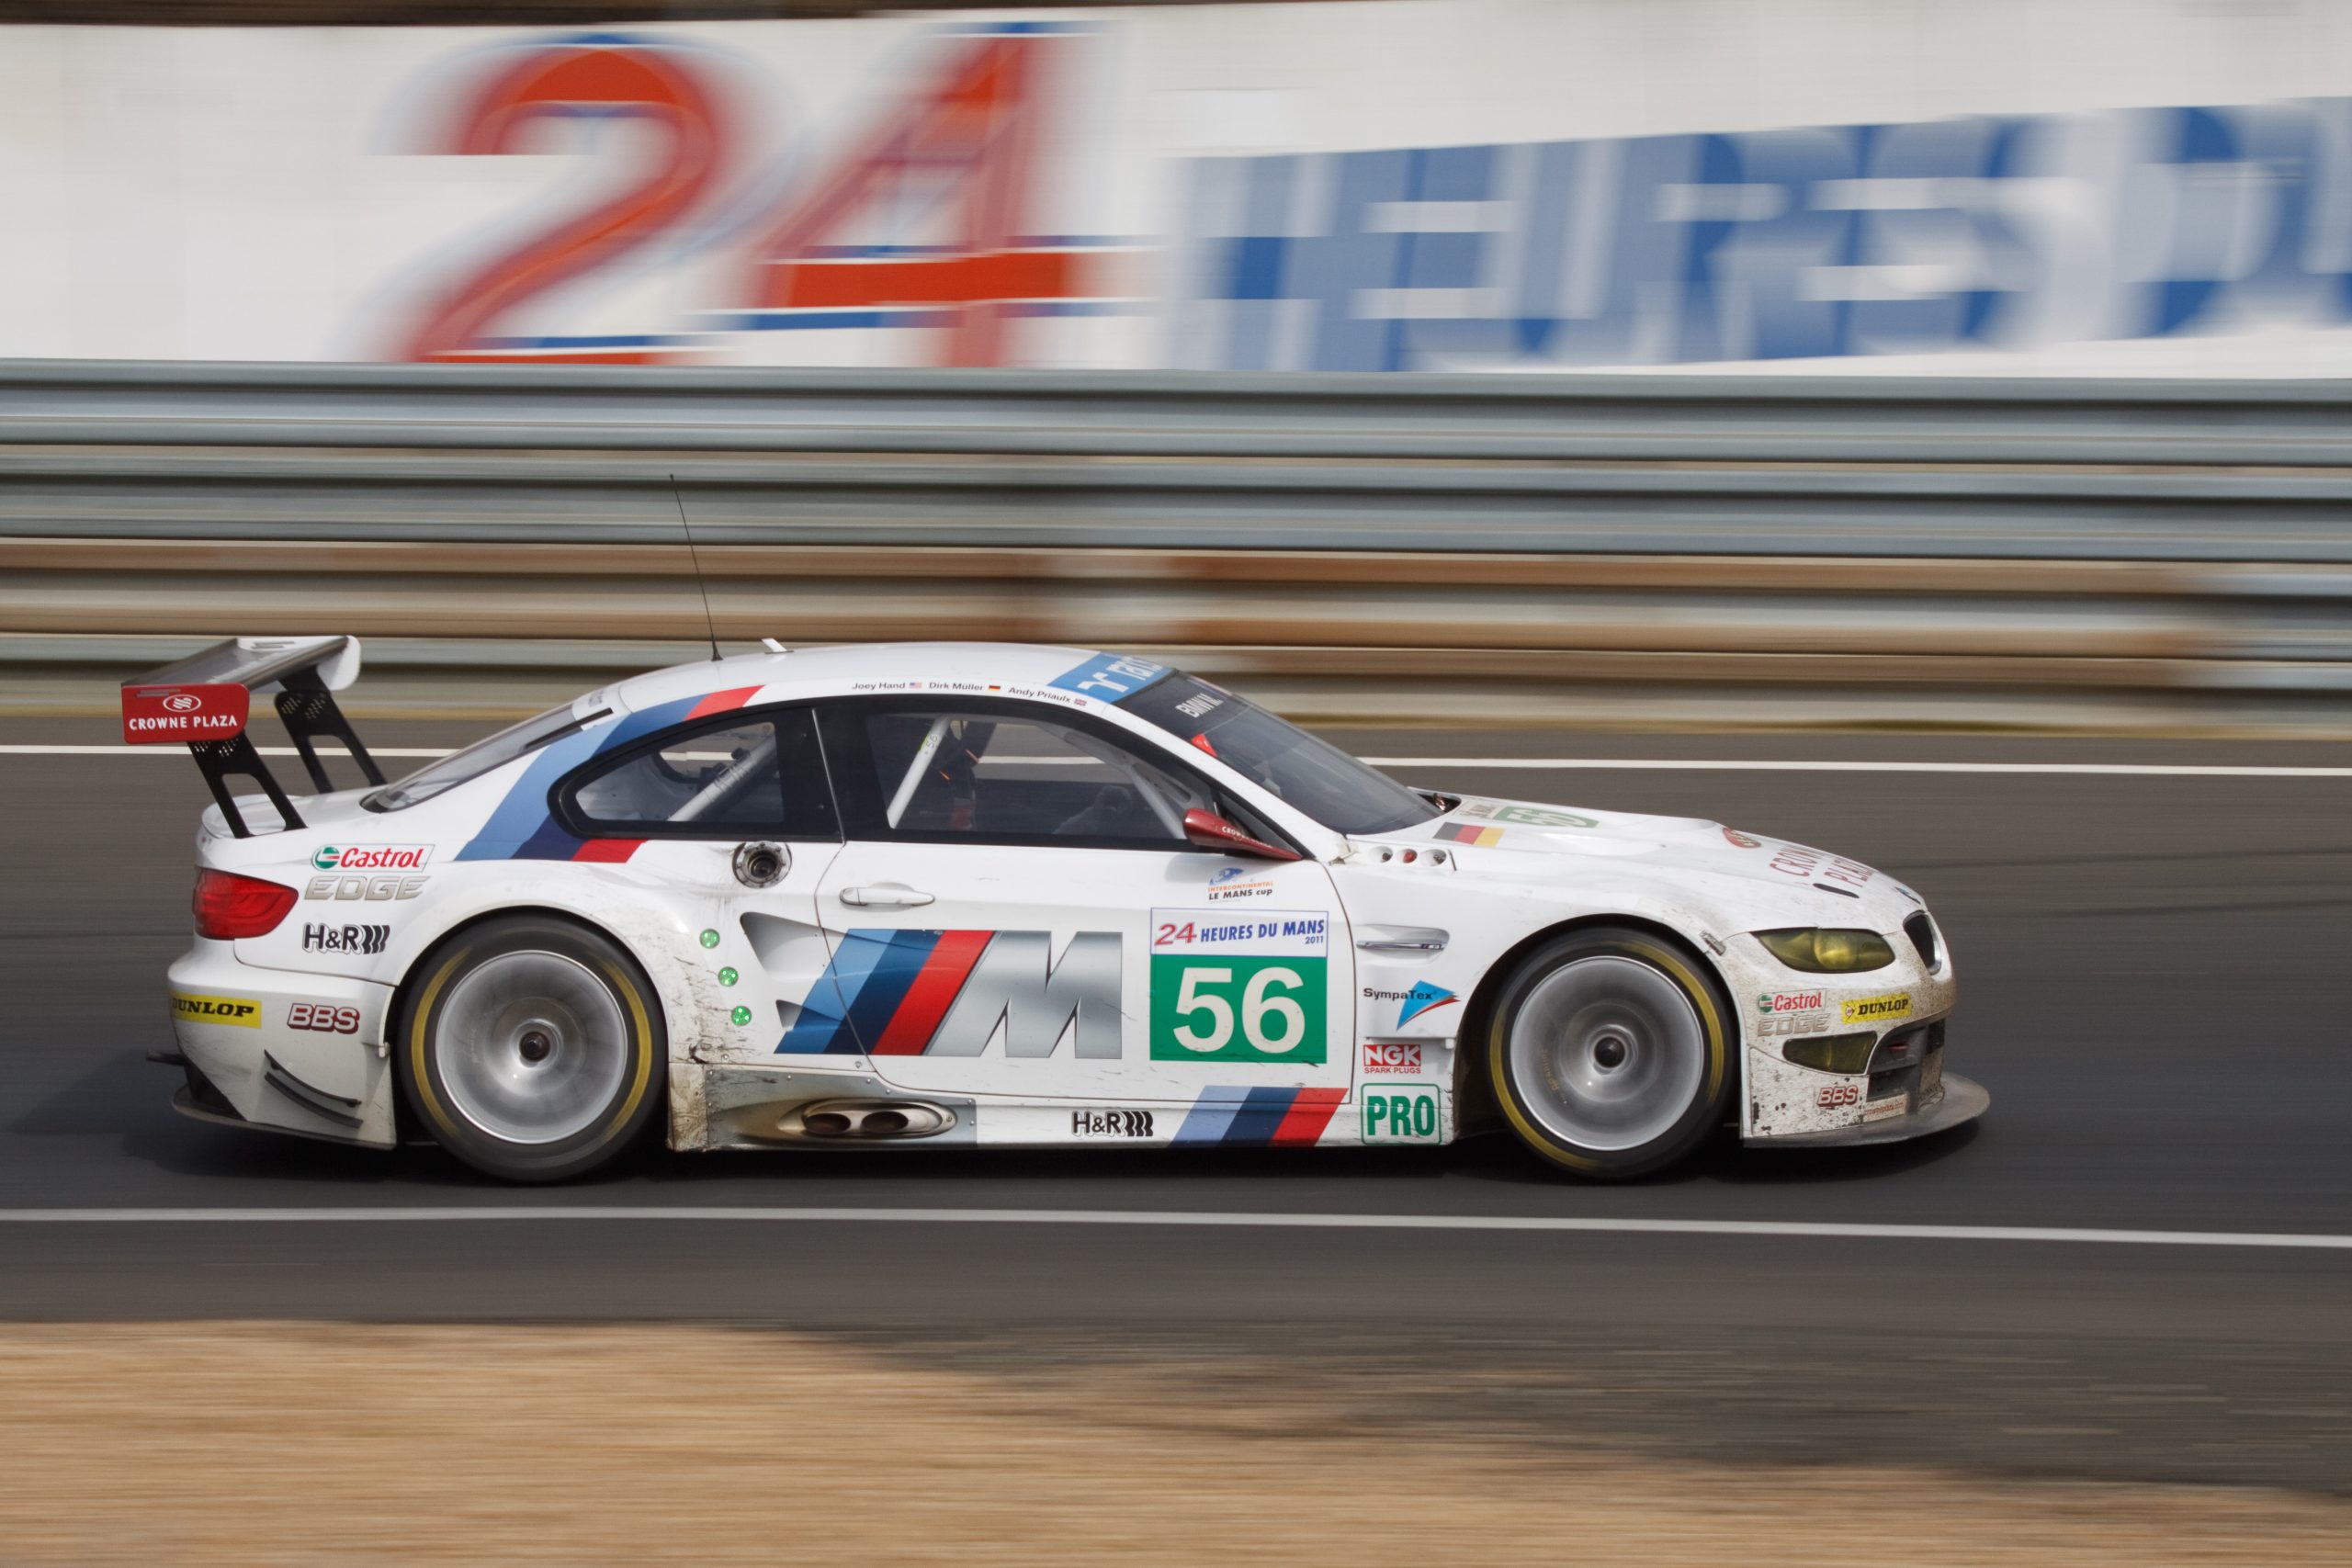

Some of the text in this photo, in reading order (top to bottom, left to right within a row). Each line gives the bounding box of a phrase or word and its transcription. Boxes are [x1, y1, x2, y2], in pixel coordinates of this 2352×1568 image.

[372, 20, 1135, 366] 24
[852, 682, 876, 691] Joey
[952, 682, 984, 691] Müller
[1008, 687, 1071, 703] Andy Priaulx
[129, 715, 238, 731] CROWNE PLAZA
[339, 846, 424, 869] Castrol
[304, 875, 431, 901] EDGE
[1223, 889, 1253, 899] MANS
[1256, 888, 1273, 897] cup
[302, 922, 365, 954] H&R
[1154, 920, 1325, 946] 24 HEURES DU MANS
[1305, 936, 1325, 945] 2011
[1363, 987, 1433, 1001] SympaTex
[1774, 991, 1823, 1012] Castrol
[172, 997, 255, 1018] DUNLOP
[1172, 966, 1306, 1054] 56
[1857, 998, 1909, 1016] DUNLOP
[287, 1002, 360, 1034] BBS
[1757, 1013, 1831, 1037] EDGE
[1364, 1045, 1421, 1066] NGK
[1364, 1066, 1421, 1075] SPARK PLUGS
[1816, 1084, 1860, 1108] BBS
[1071, 1111, 1126, 1137] H&R
[1366, 1094, 1436, 1137] PRO
